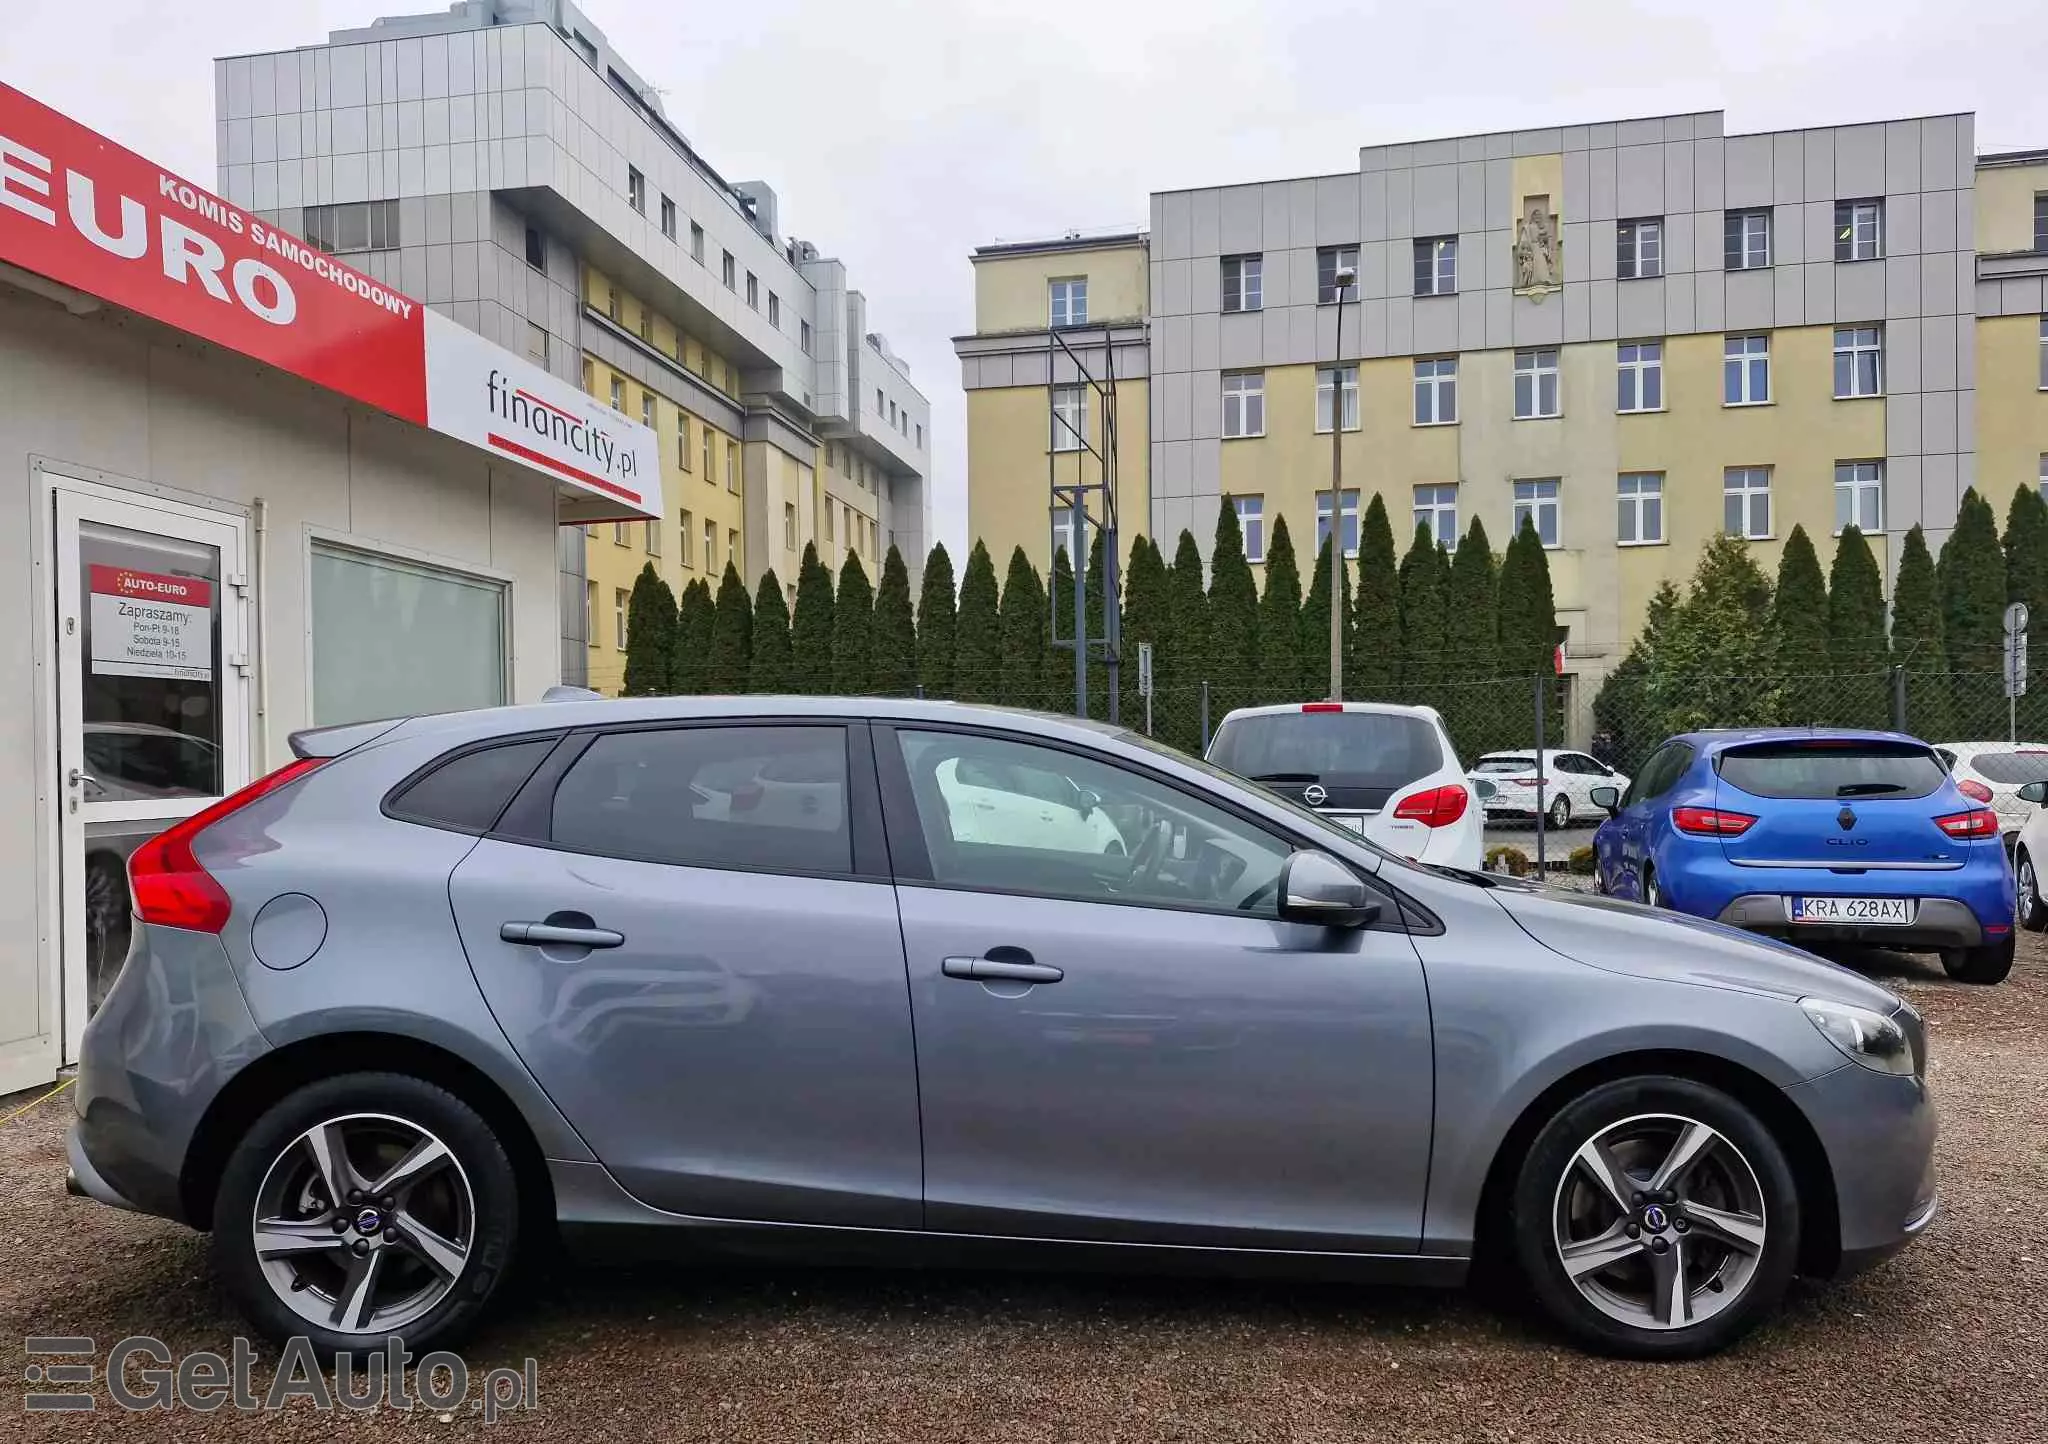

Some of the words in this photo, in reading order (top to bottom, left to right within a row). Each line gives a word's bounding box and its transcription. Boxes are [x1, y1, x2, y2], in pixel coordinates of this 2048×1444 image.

[0, 135, 297, 325] EURO
[160, 173, 244, 234] KOMIS
[251, 223, 412, 320] SAMOCHODOWY
[487, 370, 637, 478] financity.pl
[124, 578, 187, 596] AUTO-EURO
[1826, 838, 1870, 846] CLIO
[1804, 899, 1840, 917] KRA
[1846, 900, 1903, 918] 628AX
